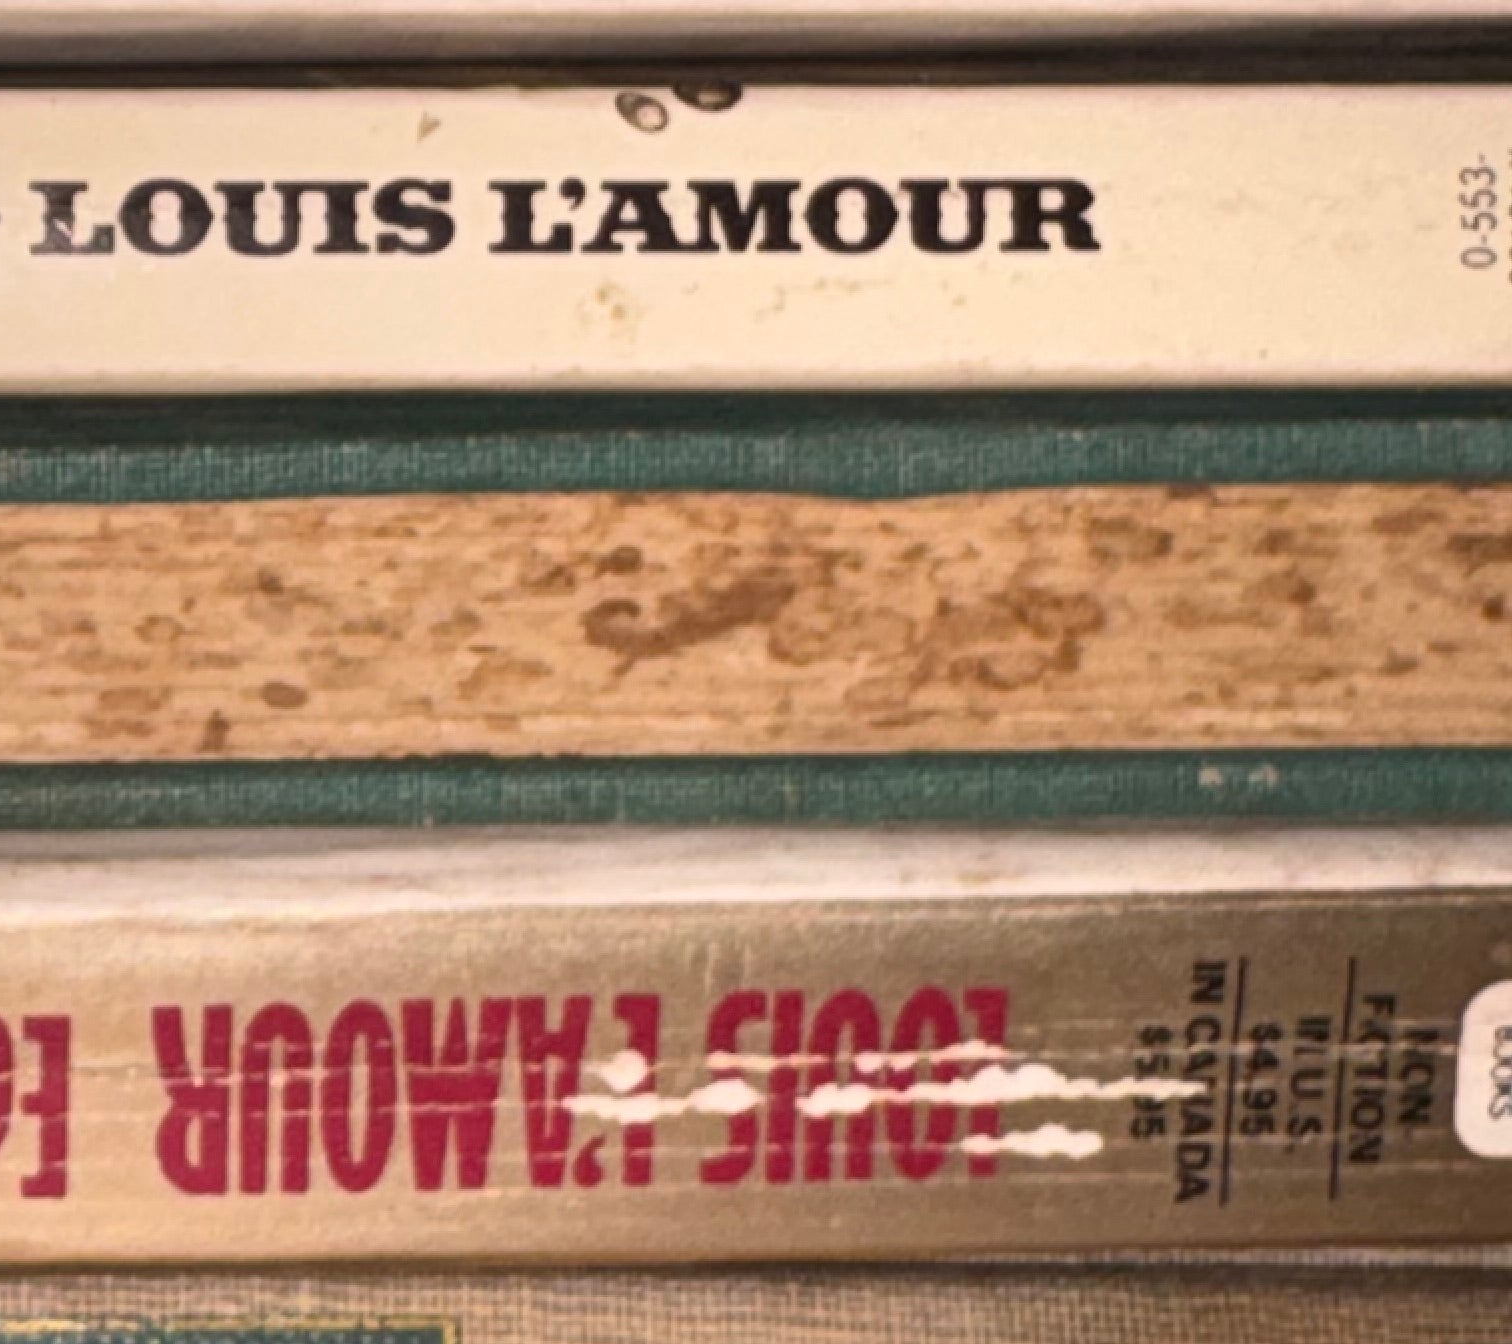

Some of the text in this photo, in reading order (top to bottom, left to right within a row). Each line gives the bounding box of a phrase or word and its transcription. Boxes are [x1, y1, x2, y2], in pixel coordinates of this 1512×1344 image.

[28, 178, 456, 256] LOUIS
[1189, 960, 1228, 1004] IN
[698, 986, 1010, 1188] LOUIS
